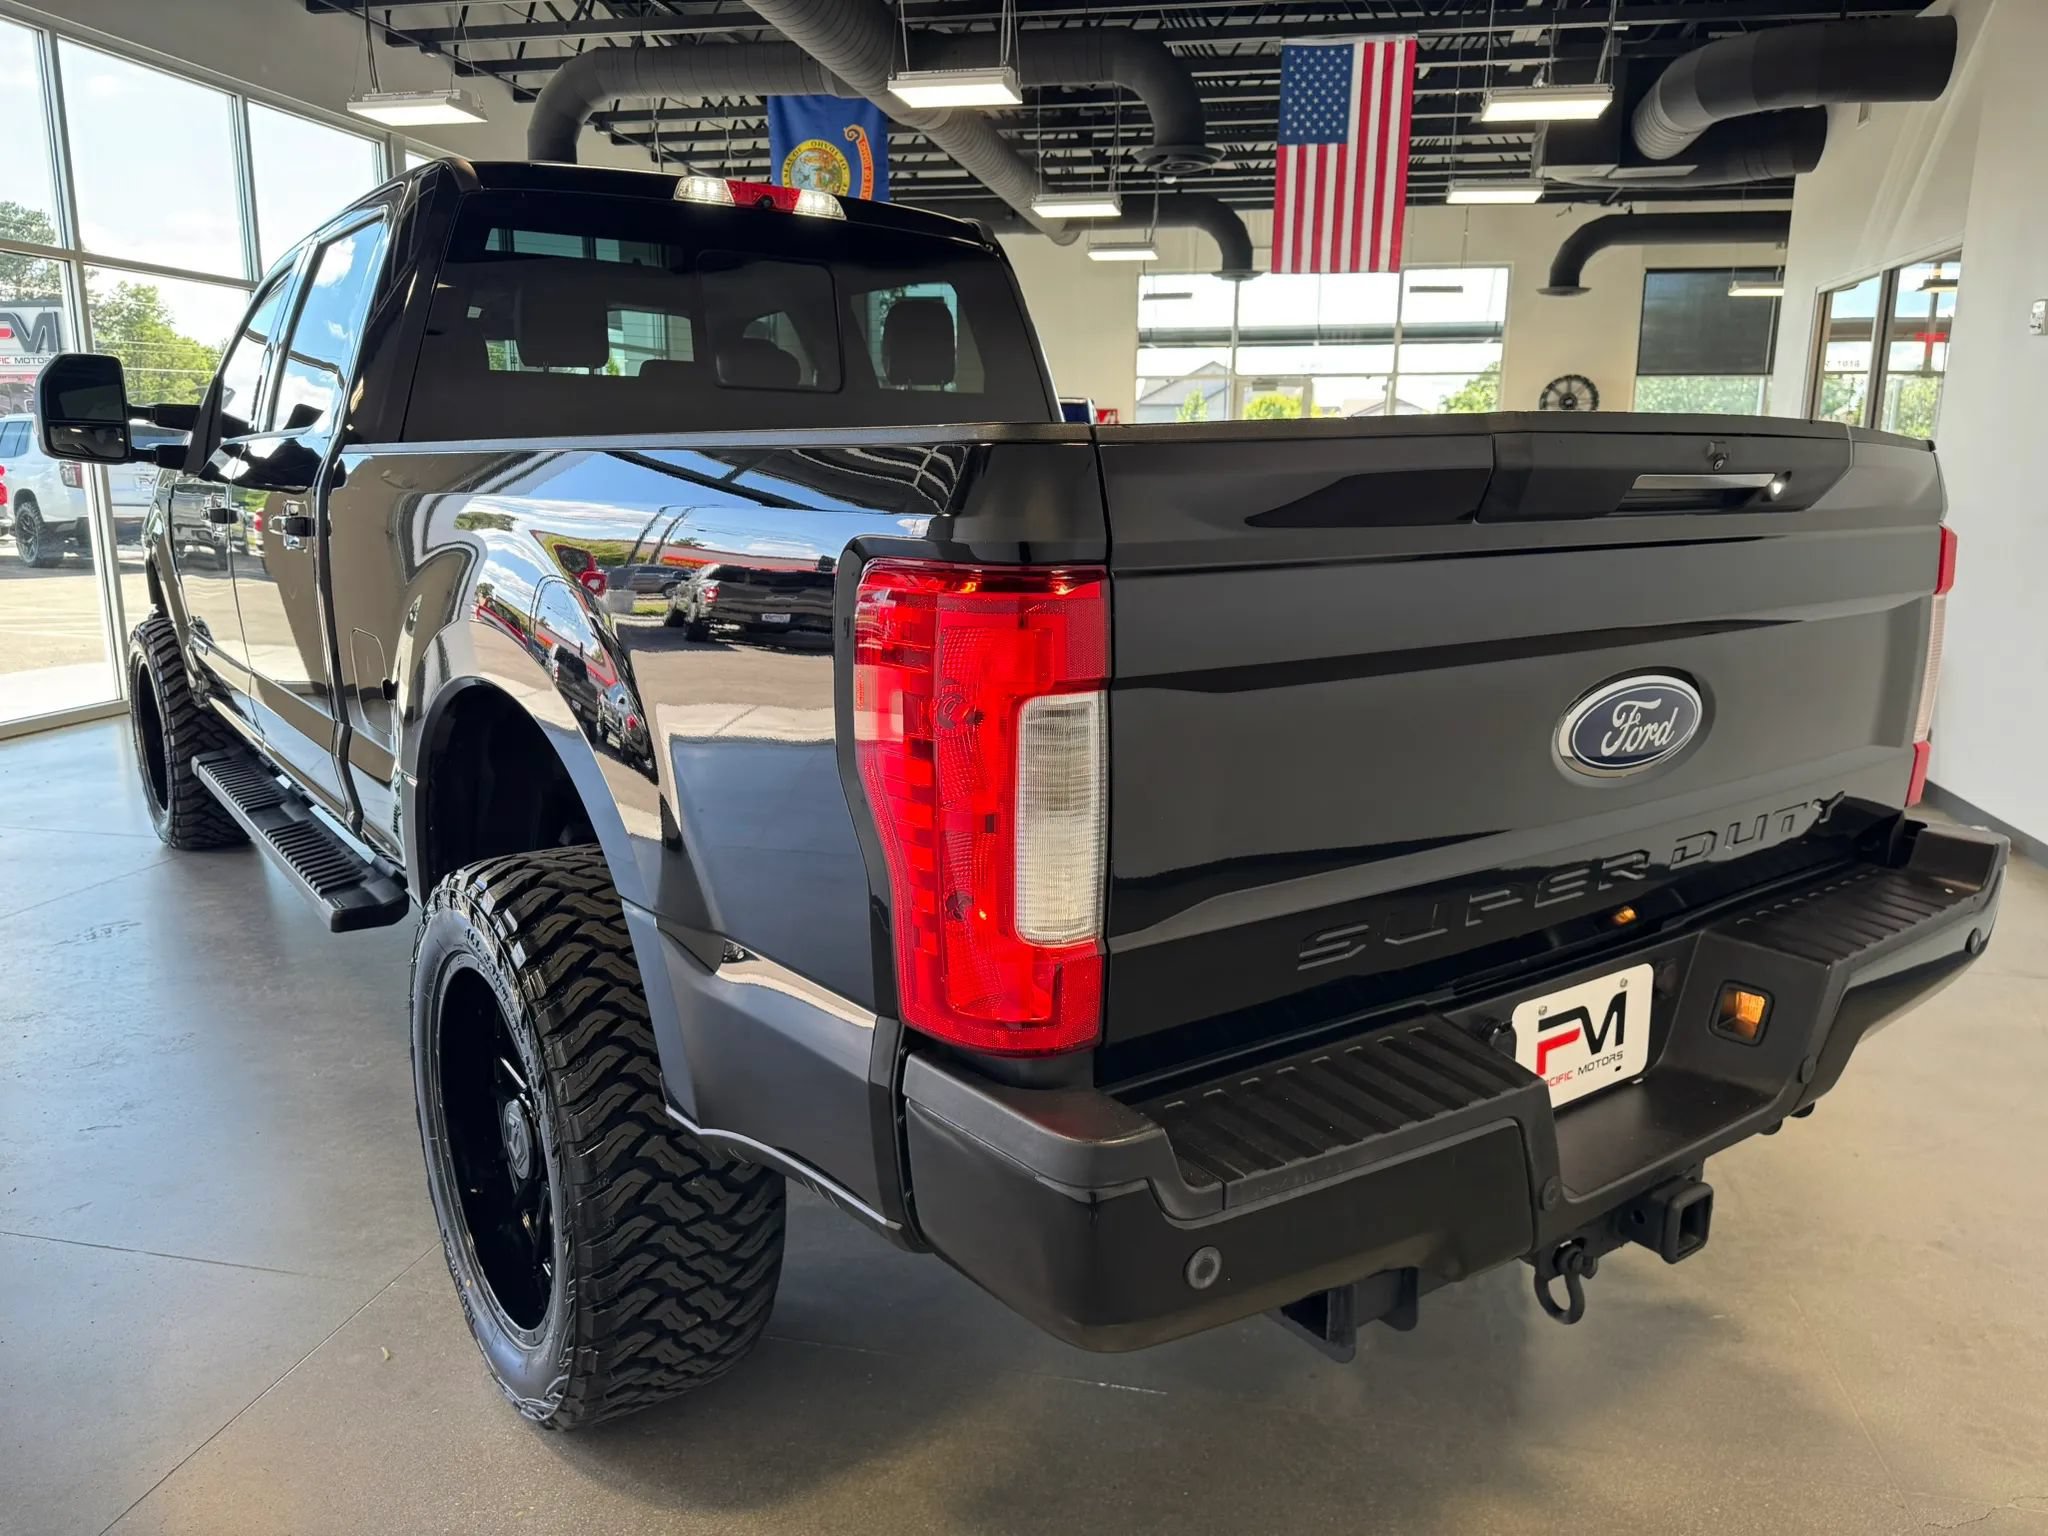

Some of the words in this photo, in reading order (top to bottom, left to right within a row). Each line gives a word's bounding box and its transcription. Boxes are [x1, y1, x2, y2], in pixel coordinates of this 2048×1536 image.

[1601, 698, 1679, 757] Ford
[1297, 849, 1651, 971] SUPER
[1670, 790, 1846, 871] DUTY
[1577, 1050, 1625, 1077] MOTORS
